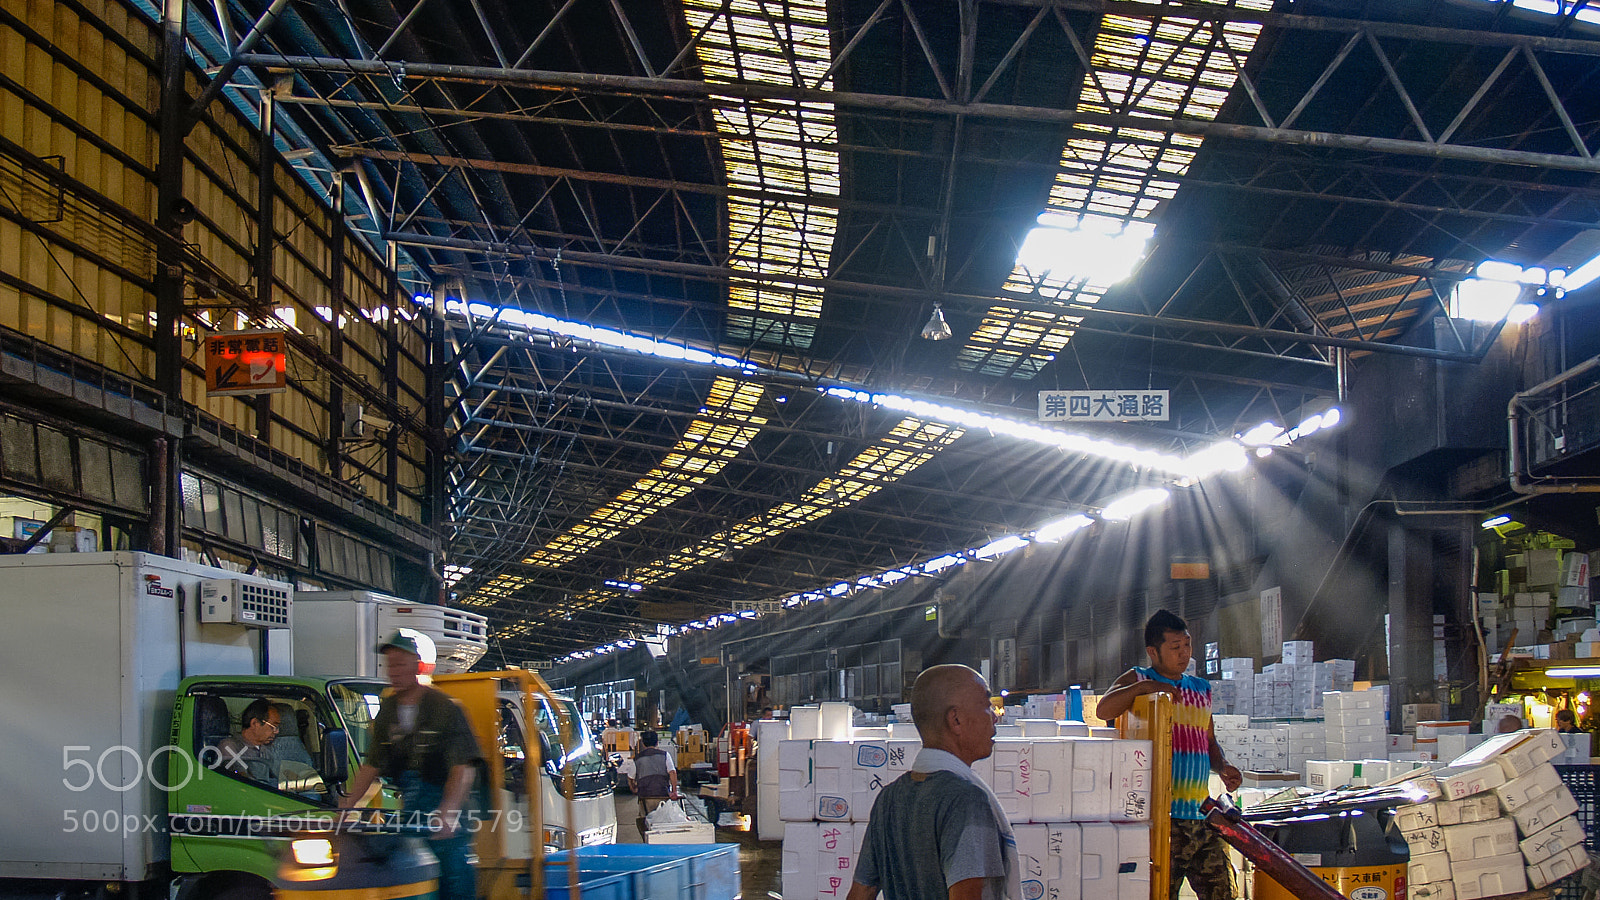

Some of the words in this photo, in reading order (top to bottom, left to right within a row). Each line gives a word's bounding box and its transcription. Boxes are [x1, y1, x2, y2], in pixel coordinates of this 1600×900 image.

[210, 337, 279, 356] 非常電話
[1045, 394, 1164, 417] 第四大通路
